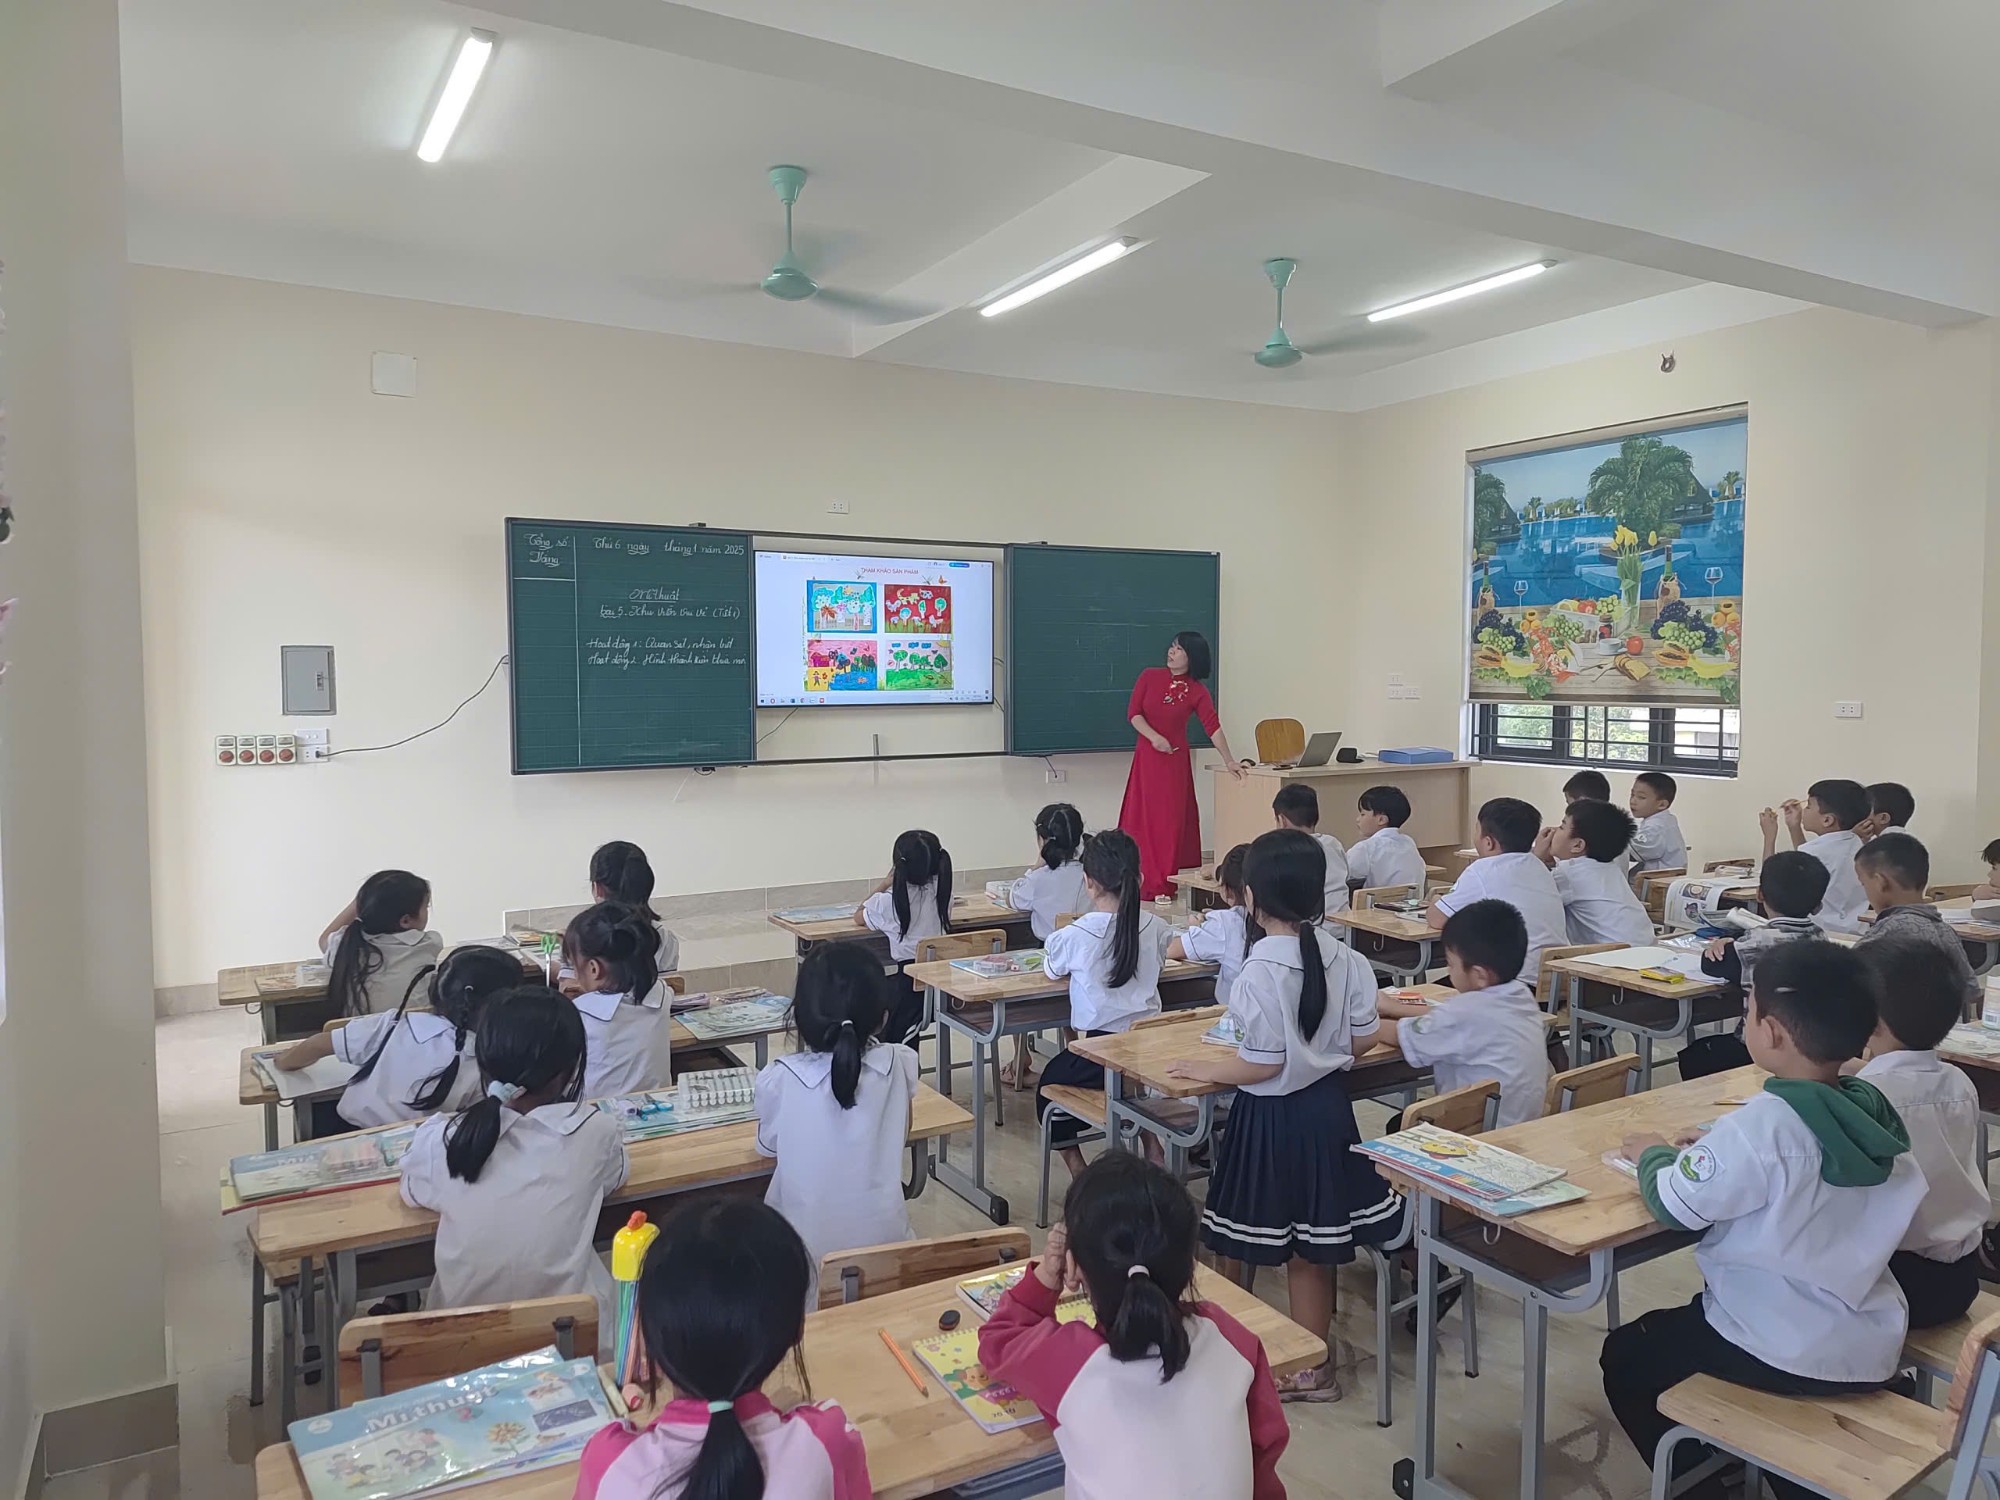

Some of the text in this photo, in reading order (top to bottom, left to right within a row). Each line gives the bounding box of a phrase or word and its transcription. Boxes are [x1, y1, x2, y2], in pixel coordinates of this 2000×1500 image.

[556, 536, 569, 547] số
[615, 539, 621, 549] 6
[627, 542, 650, 555] ngày
[664, 539, 693, 556] tháng
[702, 544, 721, 554] năm
[724, 544, 745, 556] 2025
[645, 636, 672, 649] Quan
